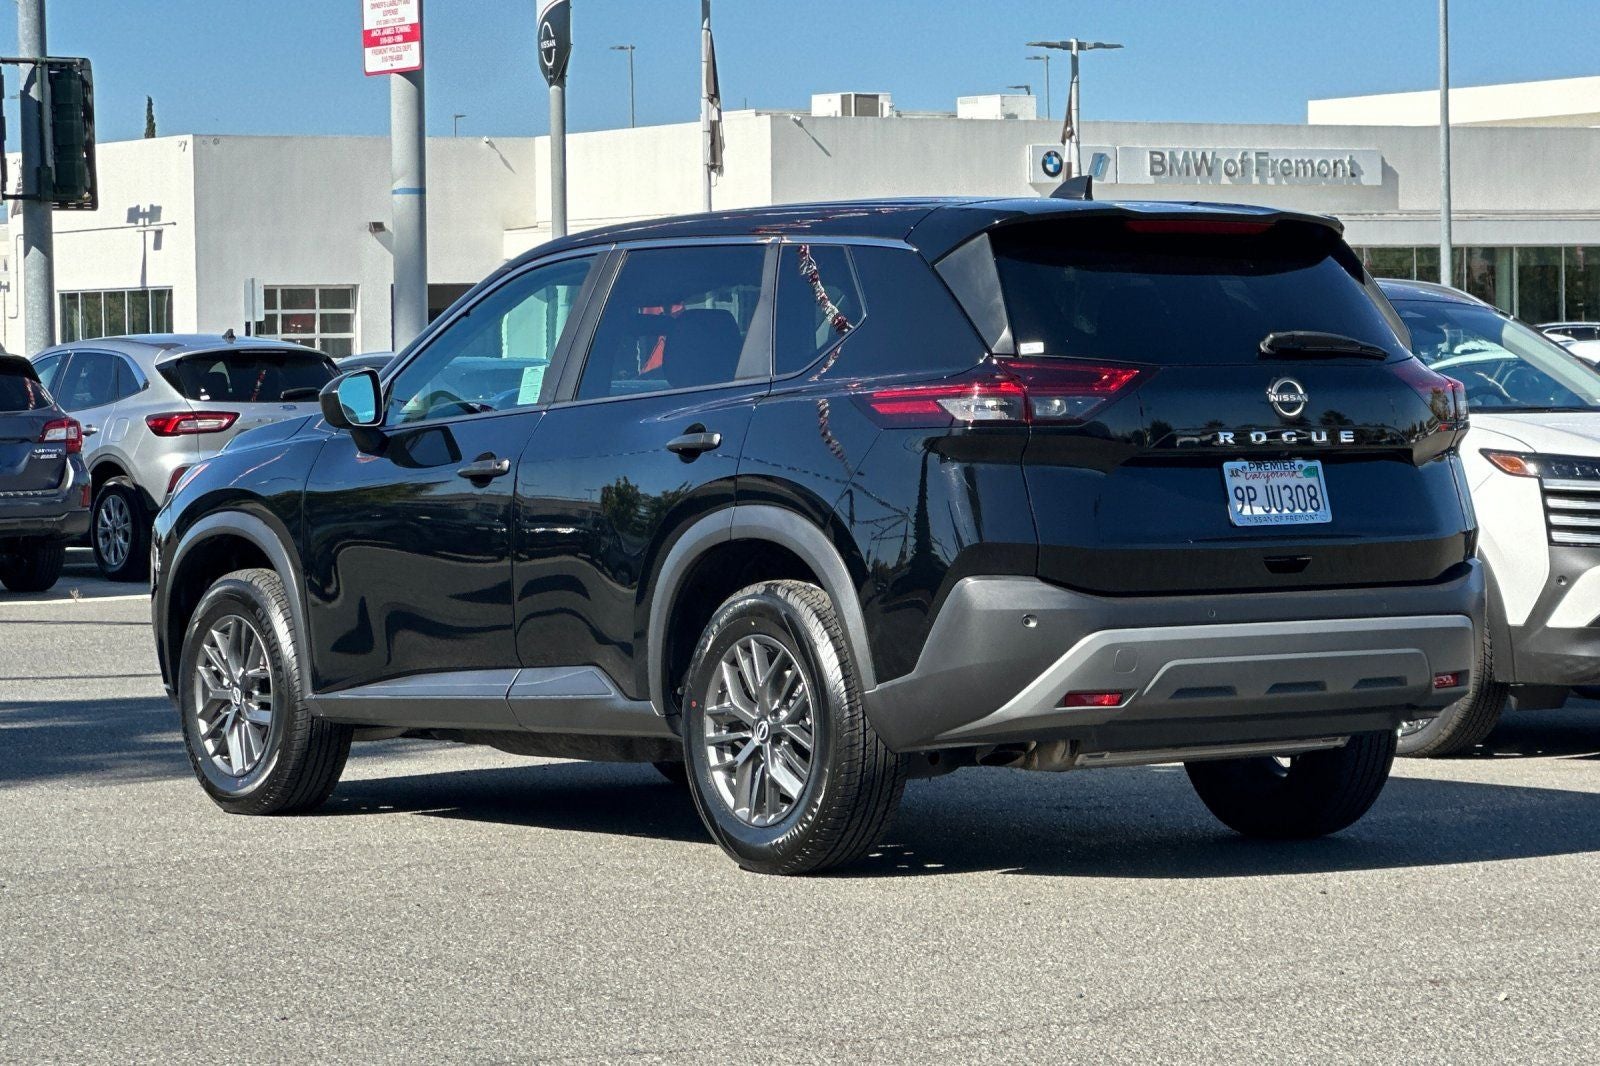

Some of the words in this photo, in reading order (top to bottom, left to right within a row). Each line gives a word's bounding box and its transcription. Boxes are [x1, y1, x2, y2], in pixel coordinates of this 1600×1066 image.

[540, 39, 556, 49] NISSAN
[1149, 150, 1216, 177] BMW
[1223, 151, 1248, 177] of
[1254, 151, 1357, 178] Fremont
[1268, 393, 1308, 403] NISSAN
[1217, 430, 1355, 444] ROGUE
[1248, 461, 1297, 472] PREMIER
[1234, 484, 1321, 515] 9PJU308
[1247, 515, 1272, 524] NISSAN
[1274, 515, 1283, 523] OF
[1285, 513, 1319, 522] FREMONT
